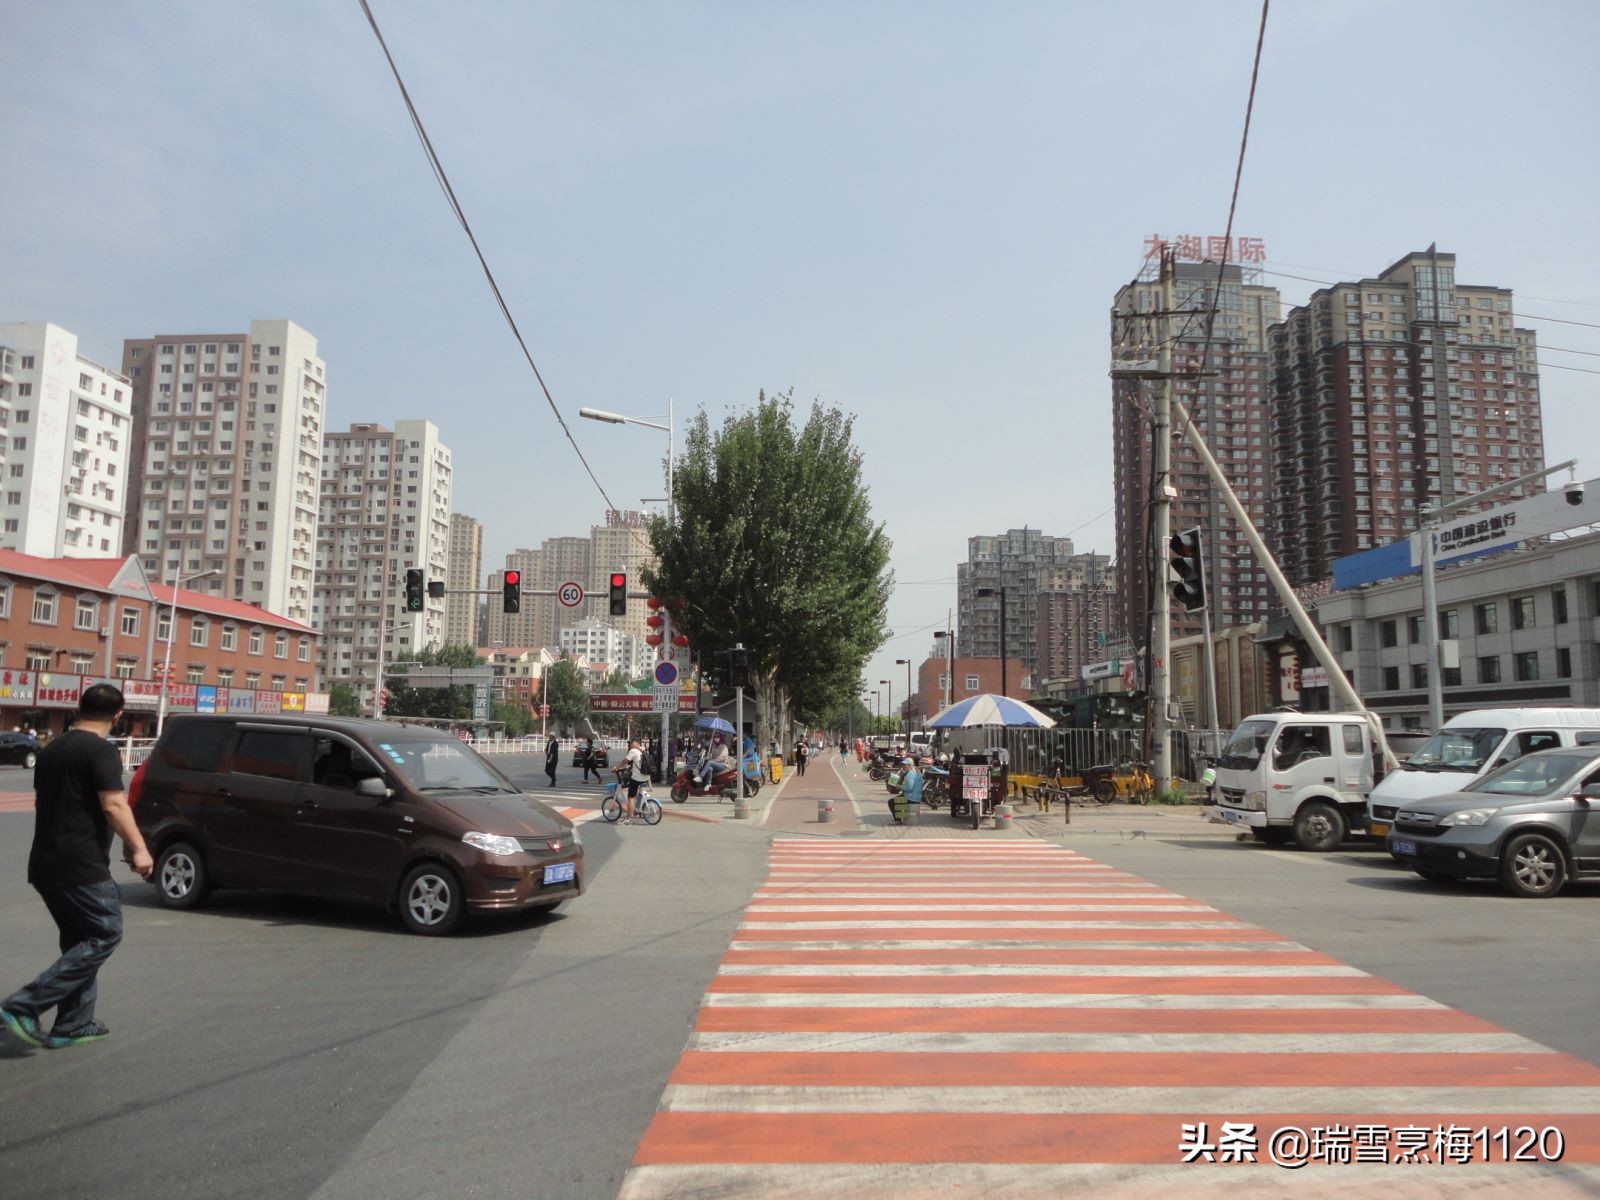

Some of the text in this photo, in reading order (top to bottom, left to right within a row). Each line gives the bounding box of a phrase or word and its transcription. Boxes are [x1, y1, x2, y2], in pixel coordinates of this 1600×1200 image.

[1440, 512, 1516, 543] 中国建设银行
[563, 588, 579, 601] 60
